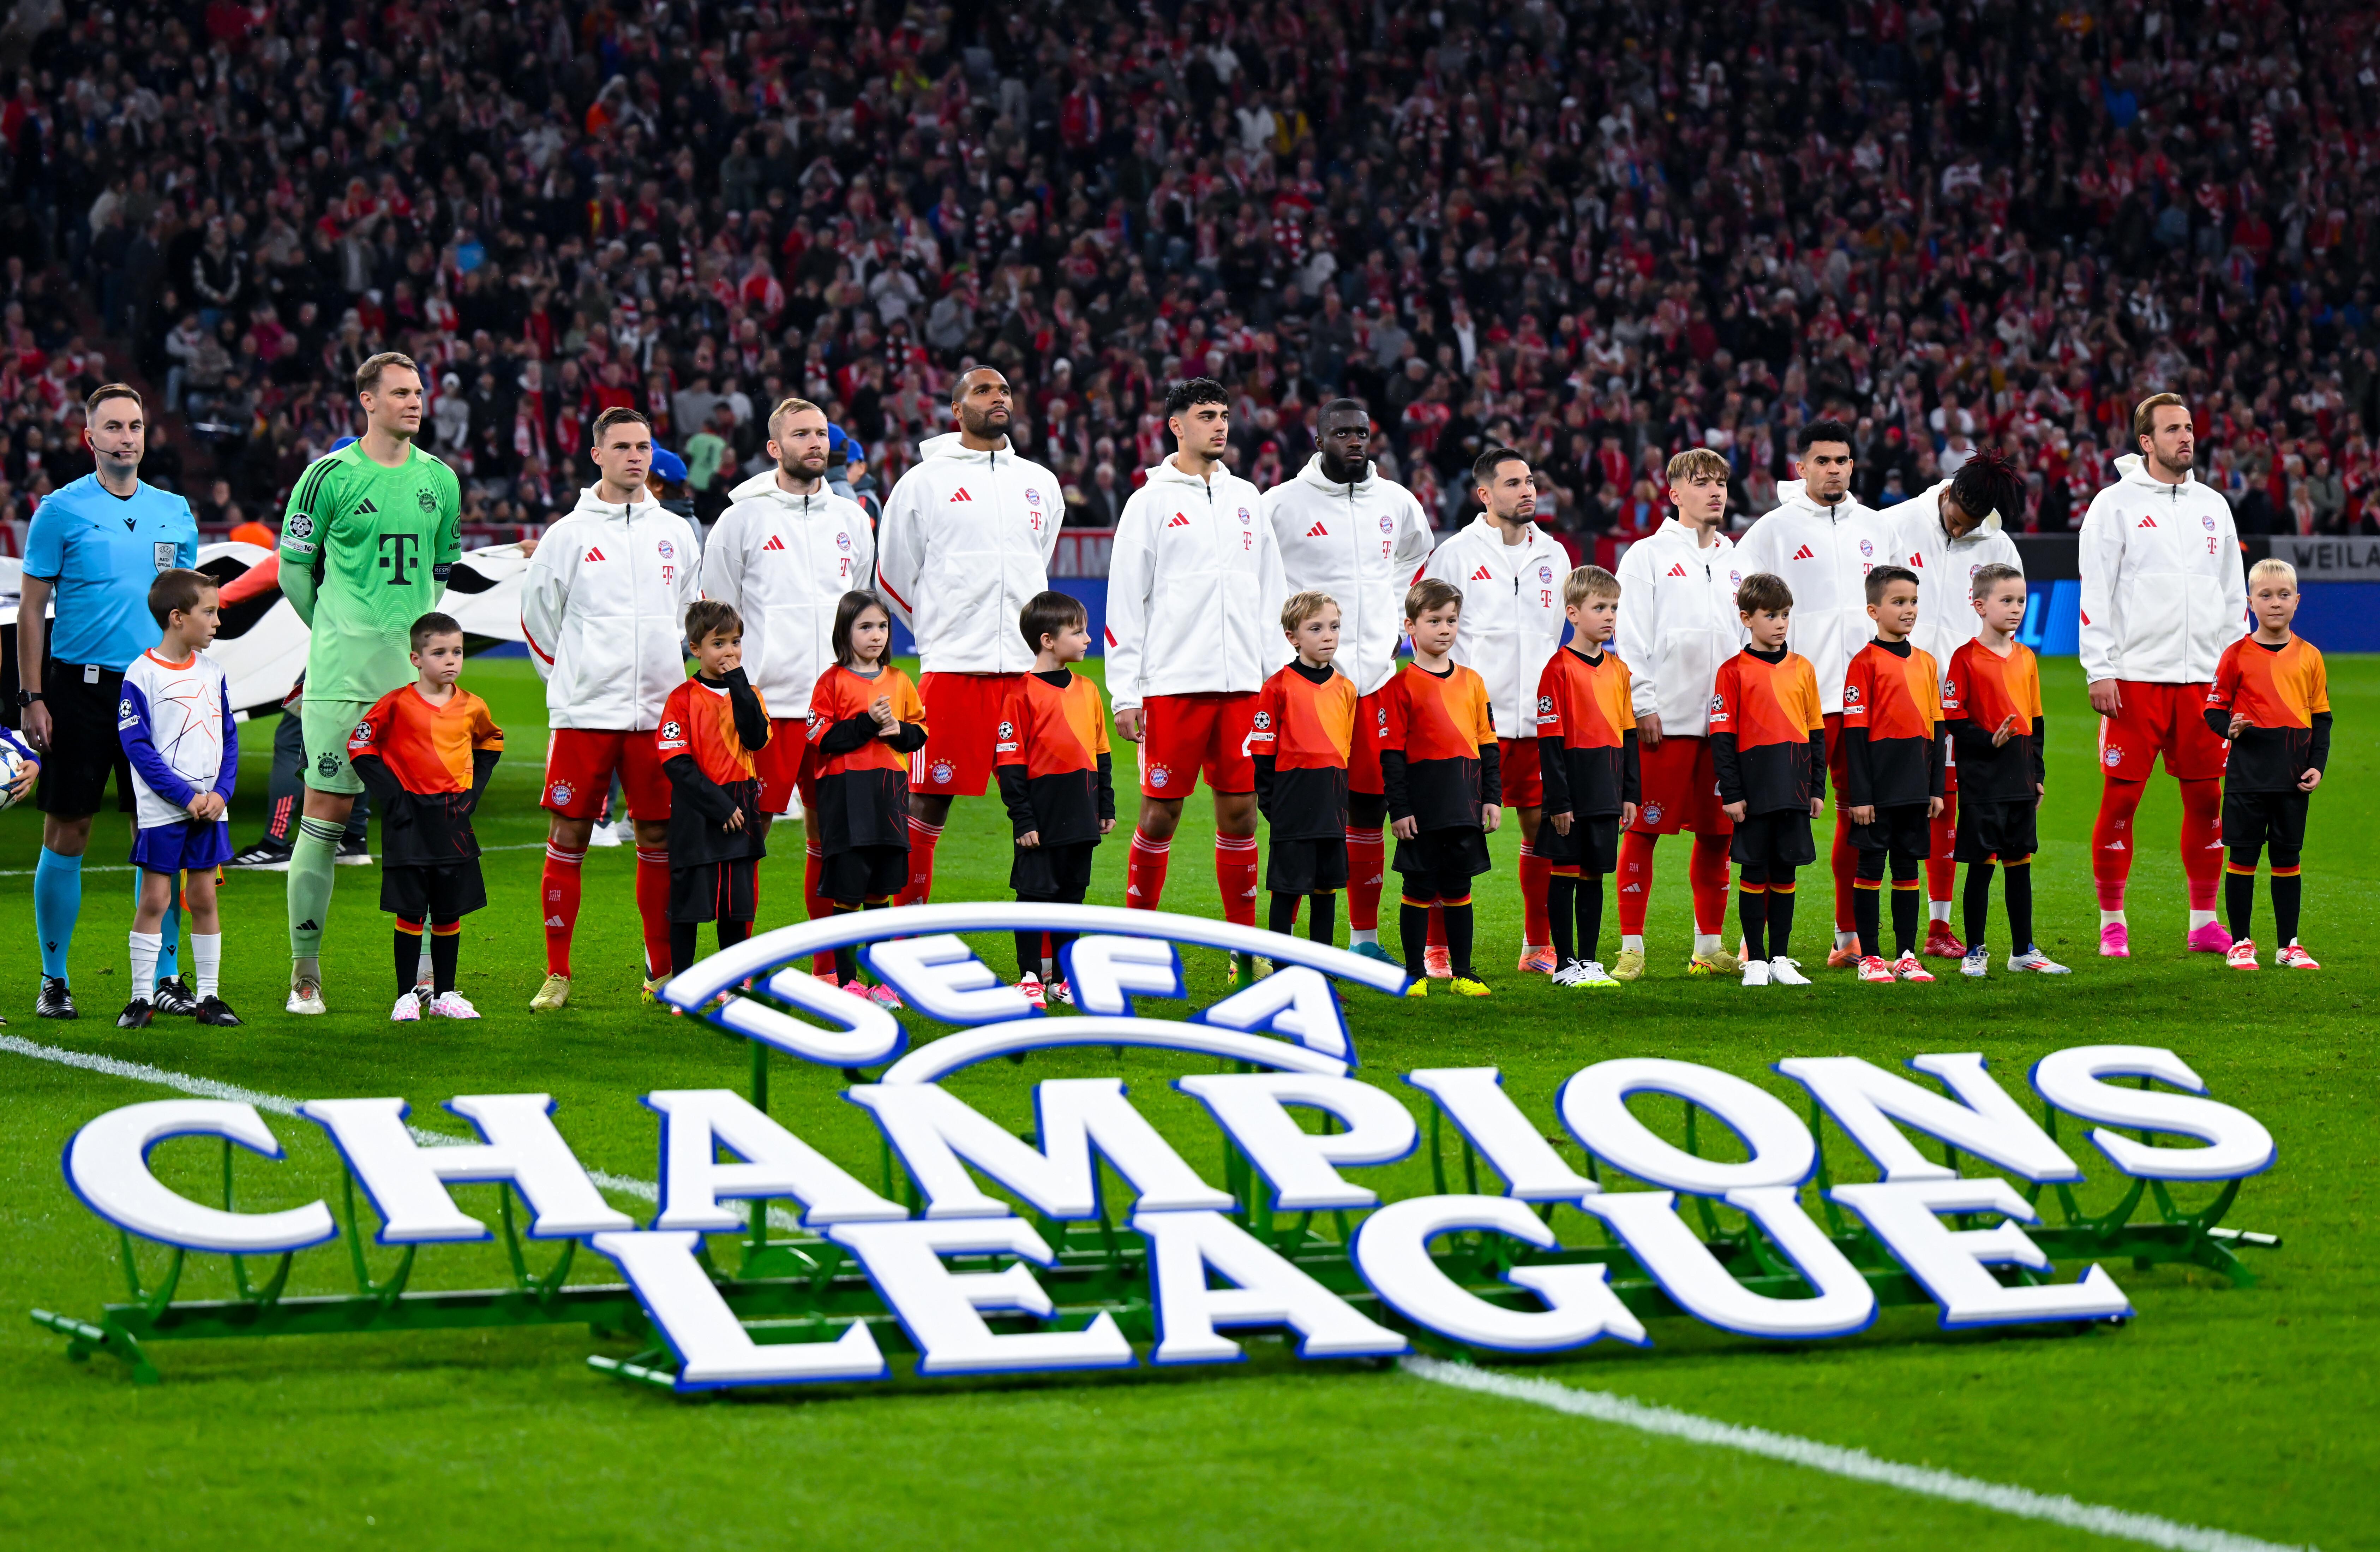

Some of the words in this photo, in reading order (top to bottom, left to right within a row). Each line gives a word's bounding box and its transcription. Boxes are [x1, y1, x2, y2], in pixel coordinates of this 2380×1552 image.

[298, 522, 304, 530] 6
[379, 534, 418, 585] T
[709, 932, 1357, 1067] UEFA
[62, 1044, 2278, 1253] CHAMPIONS
[586, 1177, 2136, 1392] LEAGUE
